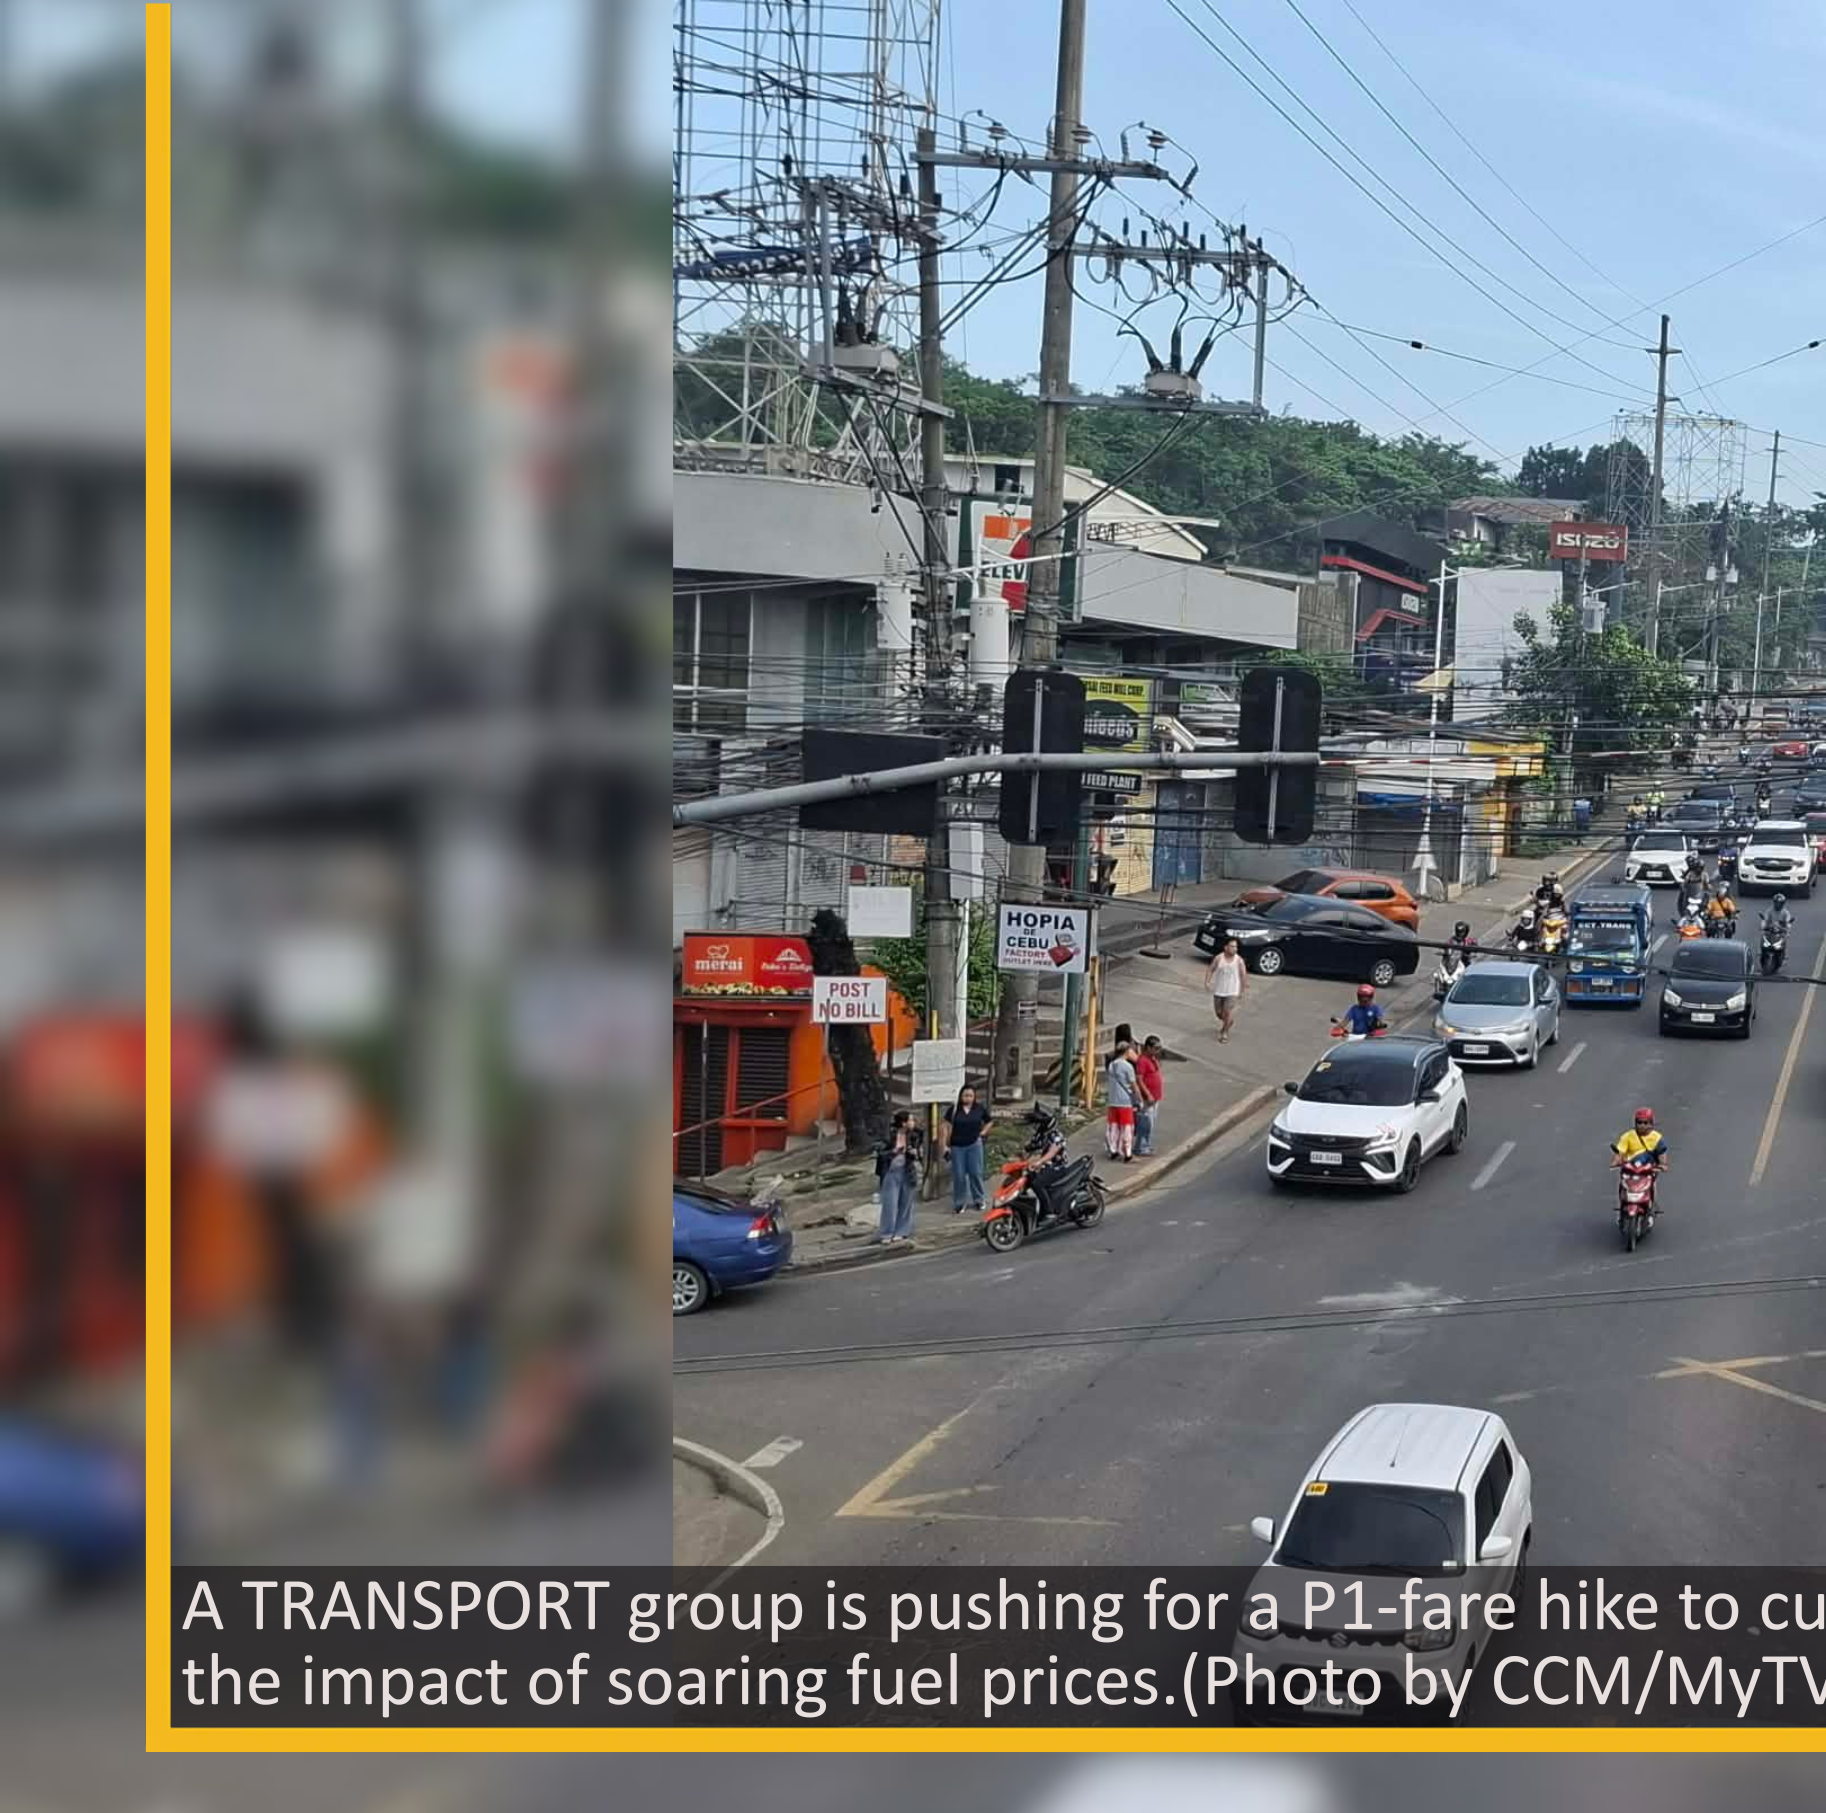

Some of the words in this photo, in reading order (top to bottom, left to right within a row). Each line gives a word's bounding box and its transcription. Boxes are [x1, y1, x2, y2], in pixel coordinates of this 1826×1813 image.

[1086, 773, 1108, 787] FEED
[1108, 775, 1138, 790] PLANT
[1006, 911, 1076, 931] HOPIA
[1006, 936, 1049, 949] CEBU
[1005, 948, 1048, 959] FACTORY
[829, 982, 871, 998] POST
[819, 1003, 841, 1018] NO
[845, 1003, 881, 1018] BILL
